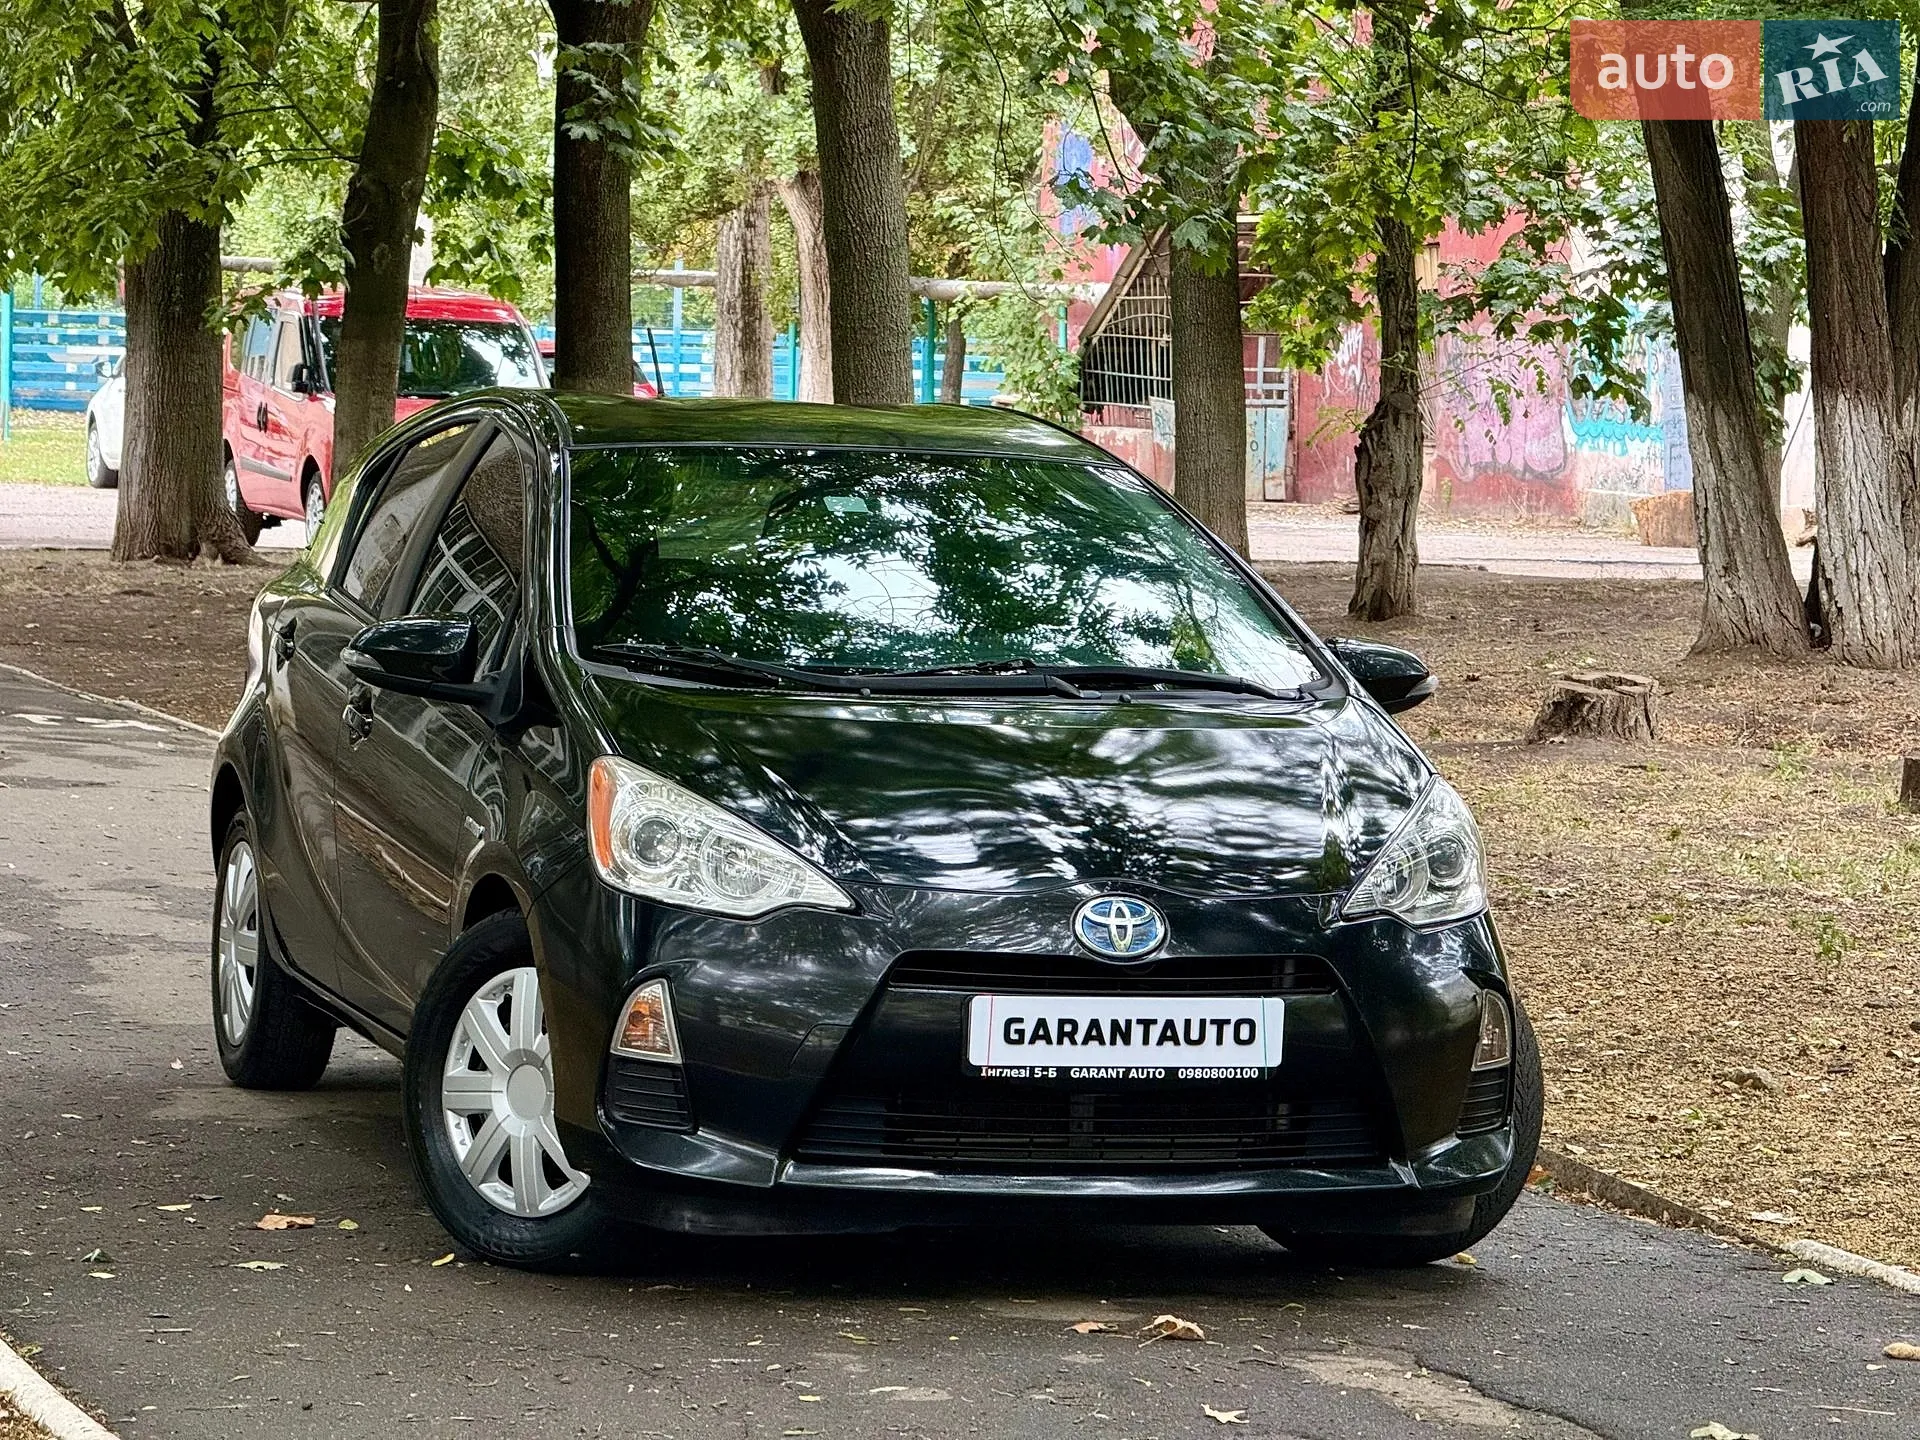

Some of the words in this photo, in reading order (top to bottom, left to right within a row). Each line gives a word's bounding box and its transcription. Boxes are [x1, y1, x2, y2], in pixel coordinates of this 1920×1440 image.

[1003, 1017, 1257, 1047] GARANTAUTO
[1033, 1067, 1057, 1079] 5-Б
[1070, 1067, 1126, 1079] GARANT
[1129, 1067, 1166, 1079] AUTO
[1178, 1067, 1259, 1080] 0980800100
